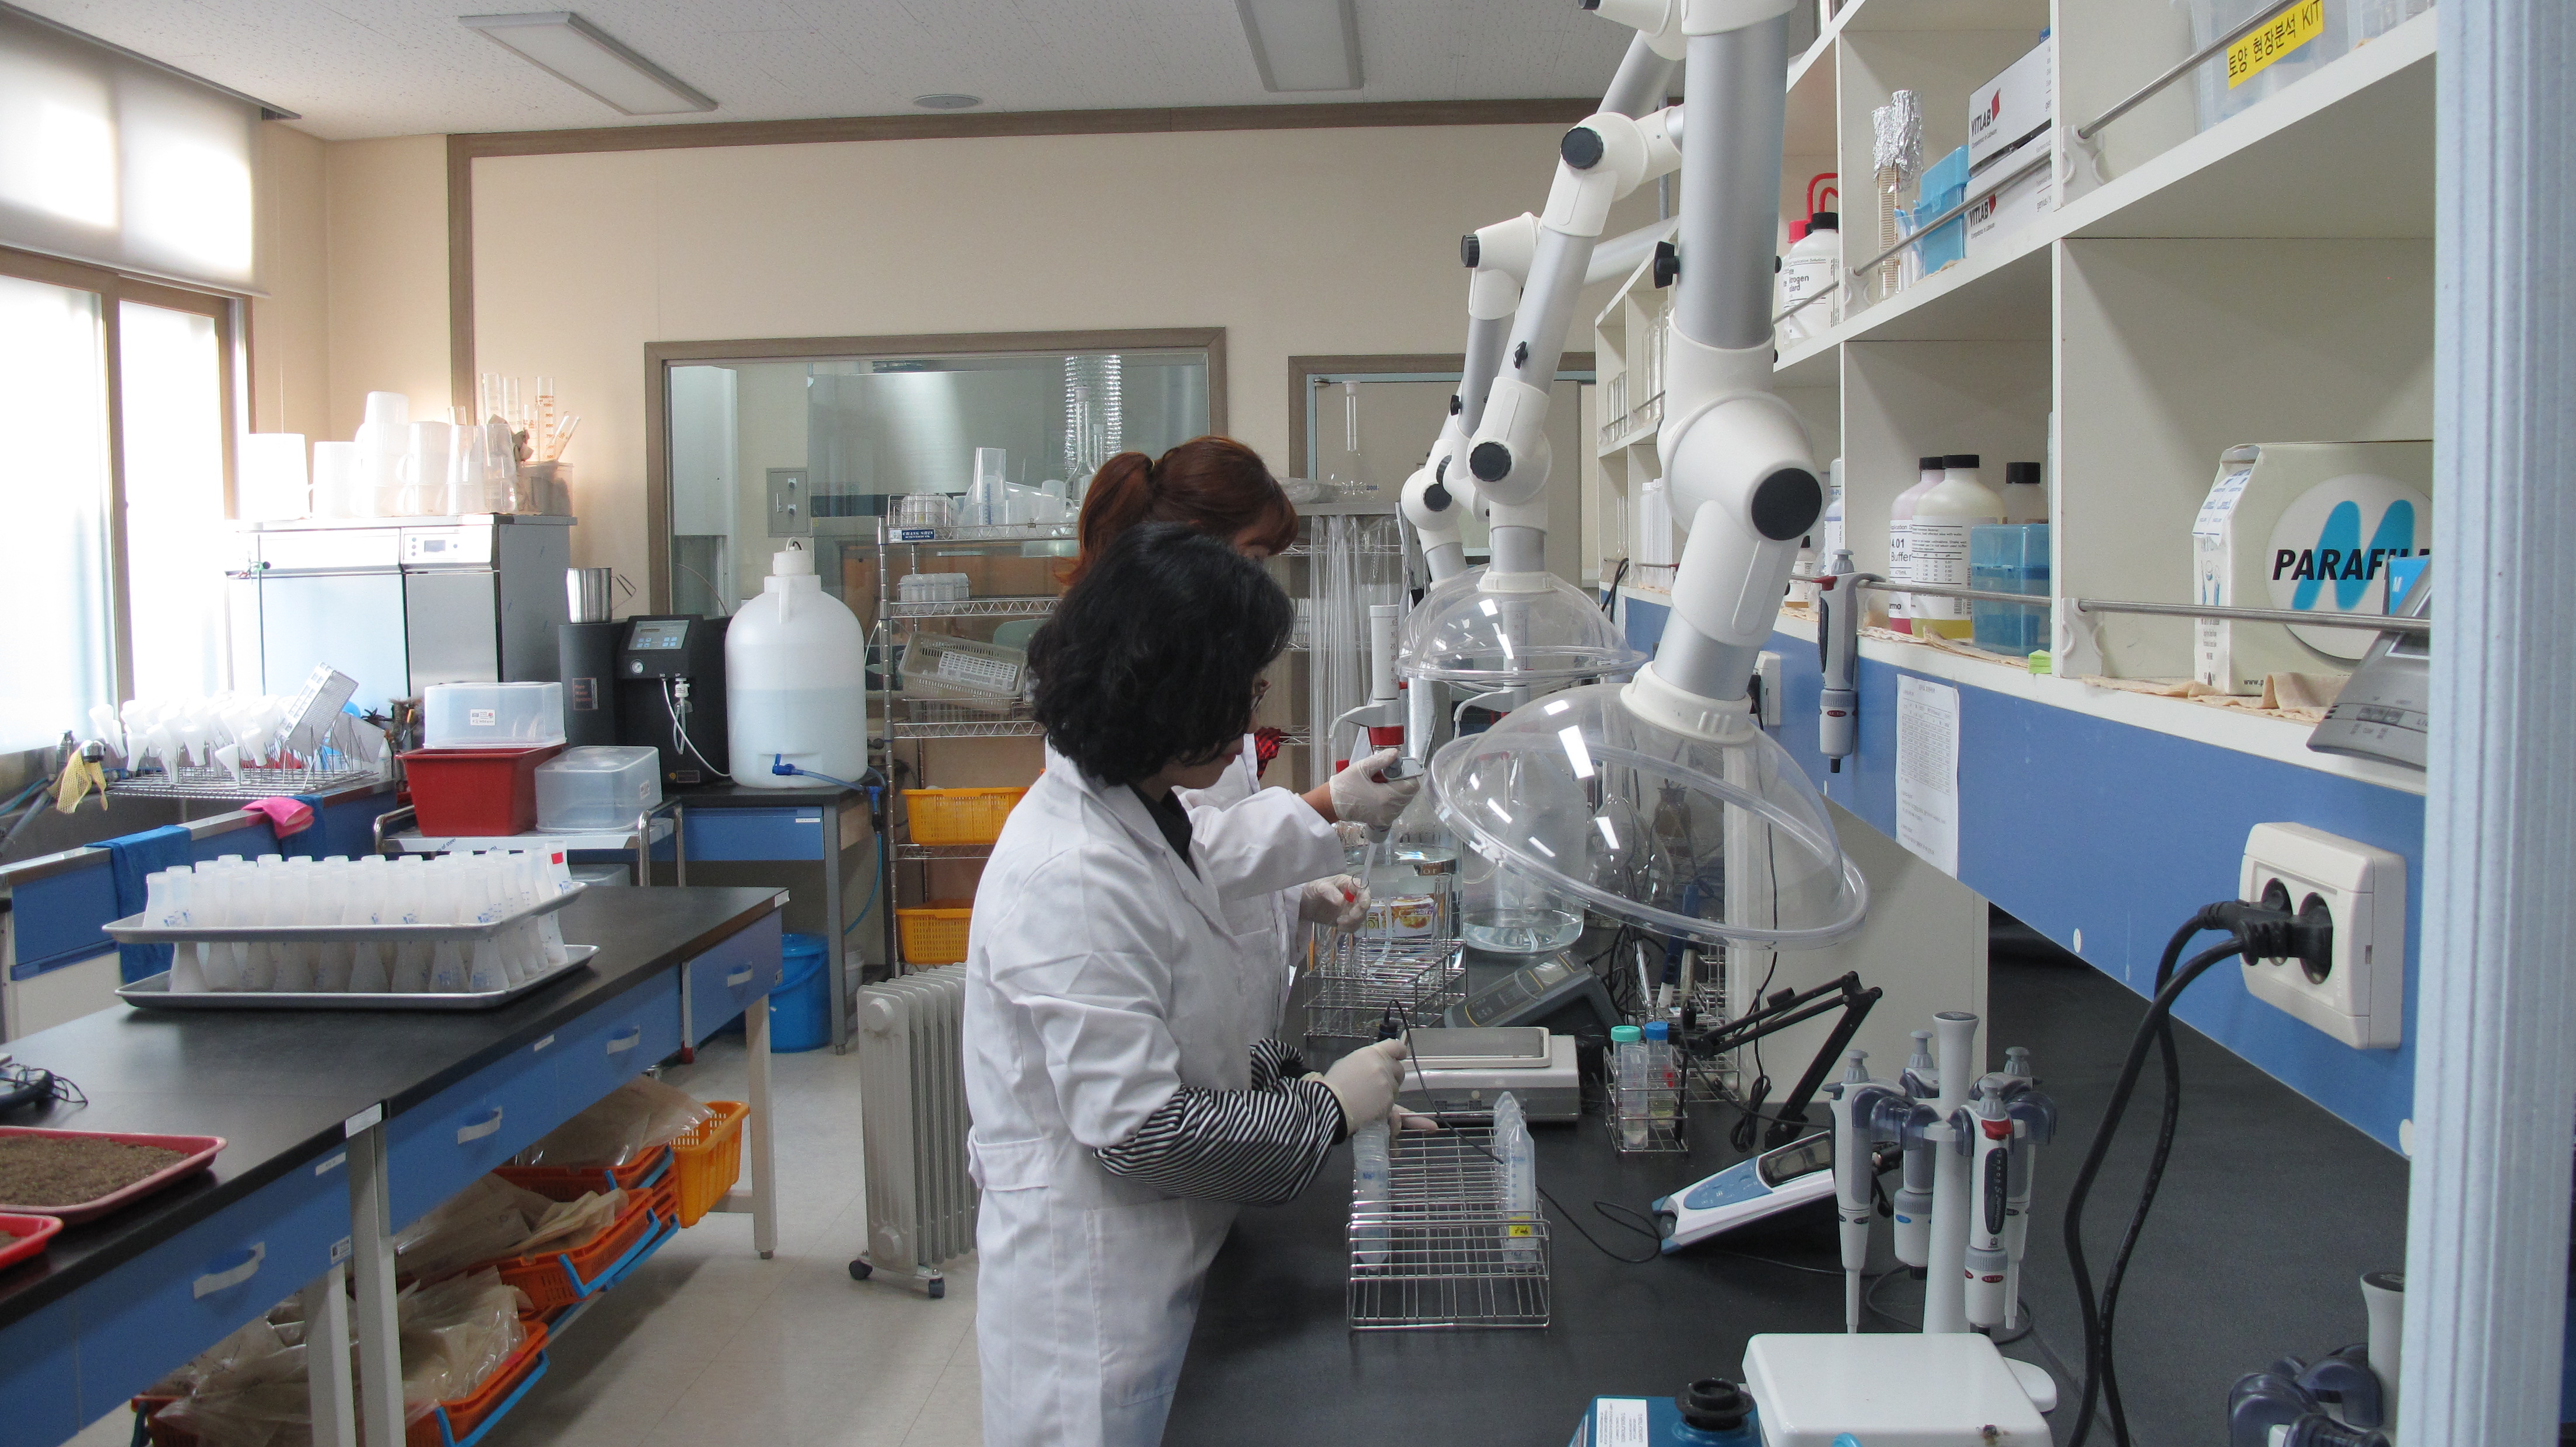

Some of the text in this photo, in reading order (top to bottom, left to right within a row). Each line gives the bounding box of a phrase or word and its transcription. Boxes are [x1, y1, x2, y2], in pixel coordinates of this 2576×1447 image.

[2228, 0, 2320, 78] 토양 현장분석 KIT
[1971, 109, 1991, 137] VITLAB
[1969, 202, 1989, 227] VITLAB
